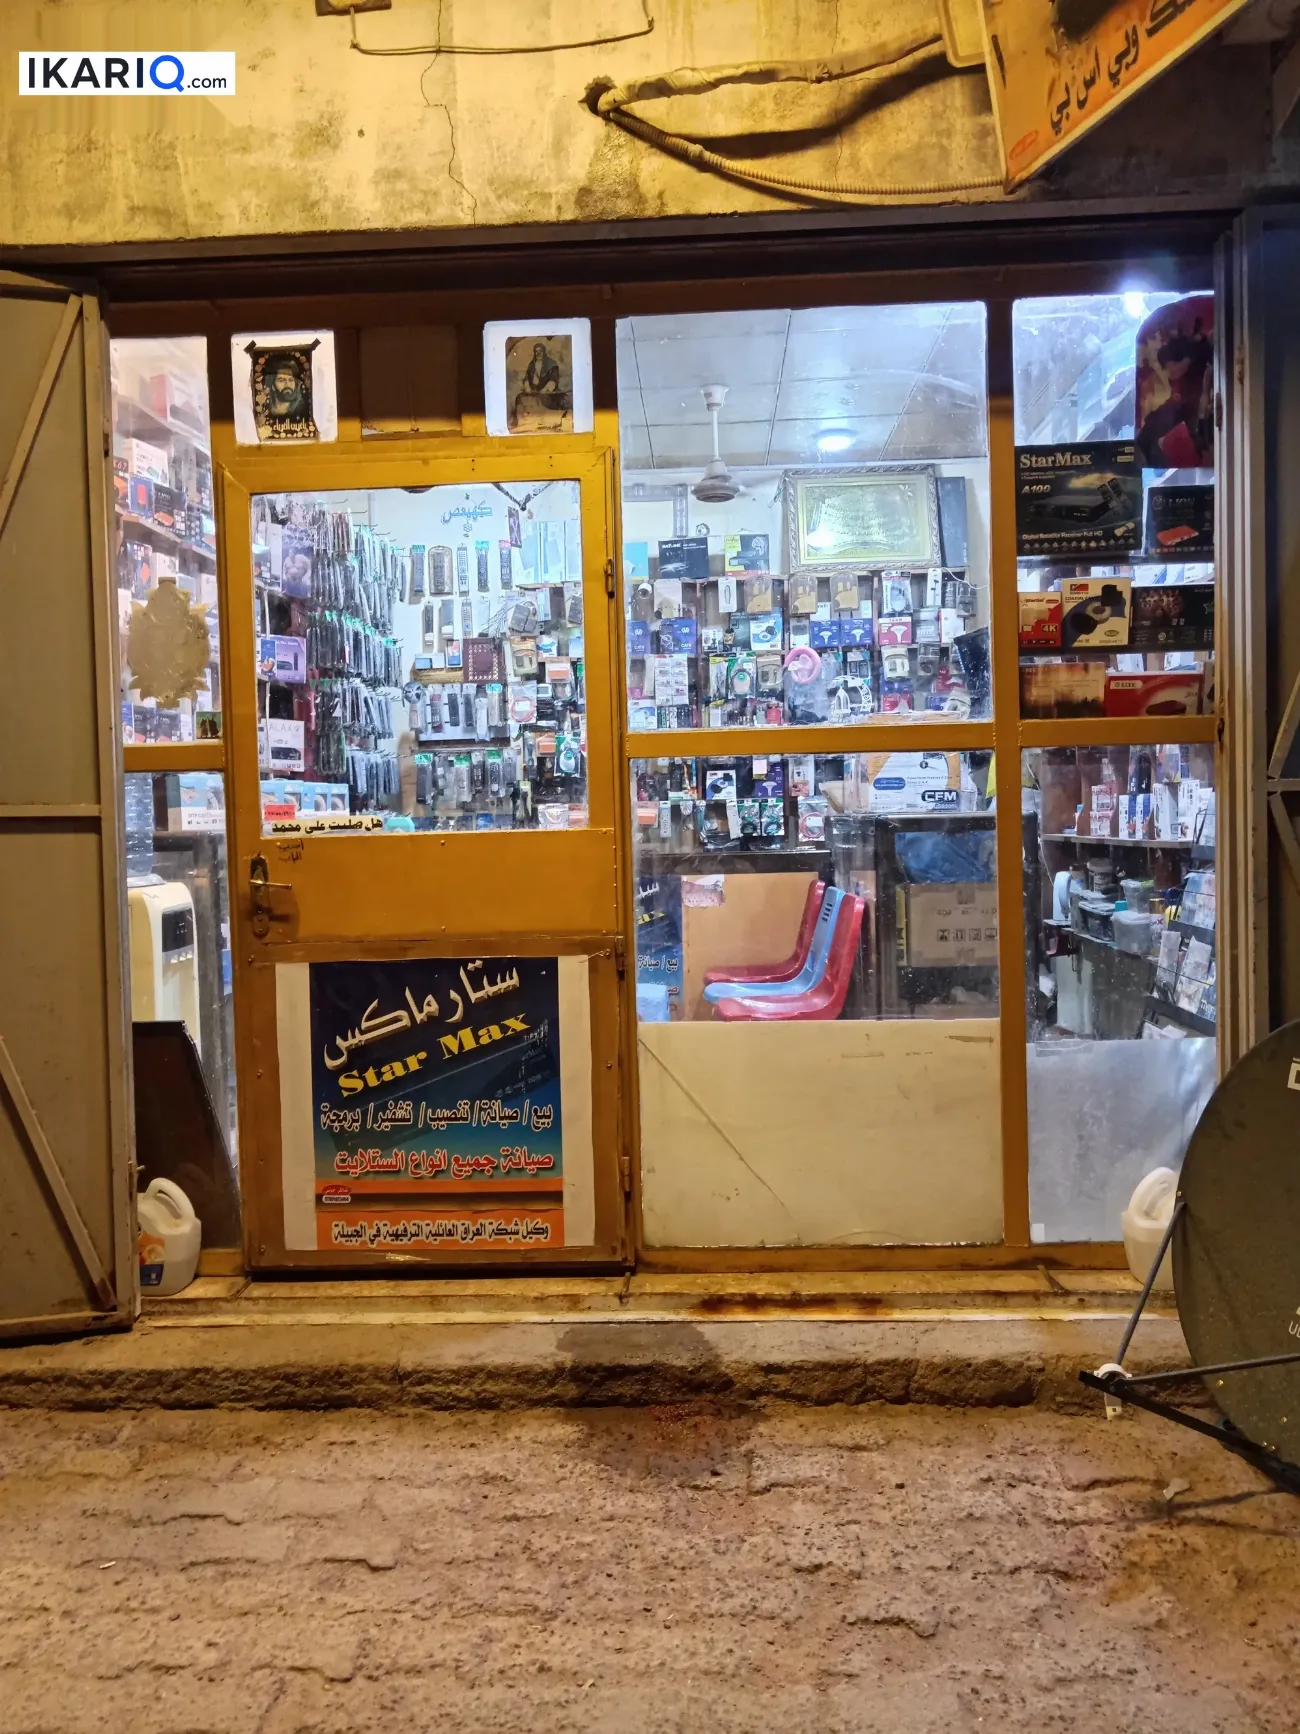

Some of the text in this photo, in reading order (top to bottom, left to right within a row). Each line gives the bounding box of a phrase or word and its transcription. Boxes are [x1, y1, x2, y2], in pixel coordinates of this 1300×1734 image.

[1019, 452, 1093, 469] StarMax
[1021, 485, 1051, 494] A100
[1043, 624, 1056, 632] 4K
[272, 817, 383, 834] هل صليت على محمد
[324, 960, 520, 1071] ستار ماكس
[338, 1050, 428, 1098] Star
[436, 1013, 531, 1060] Max
[321, 1103, 361, 1132] برمجة
[376, 1100, 413, 1131] تشفير
[427, 1100, 471, 1130] تنصيب
[481, 1100, 520, 1128] صيانة
[531, 1103, 554, 1132] بيع
[334, 1146, 554, 1180] صيانة جميع انواع الستلايت
[368, 1223, 381, 1245] في
[460, 1221, 487, 1242] العراق
[488, 1220, 520, 1243] شبكة
[521, 1220, 550, 1242] وكيل
